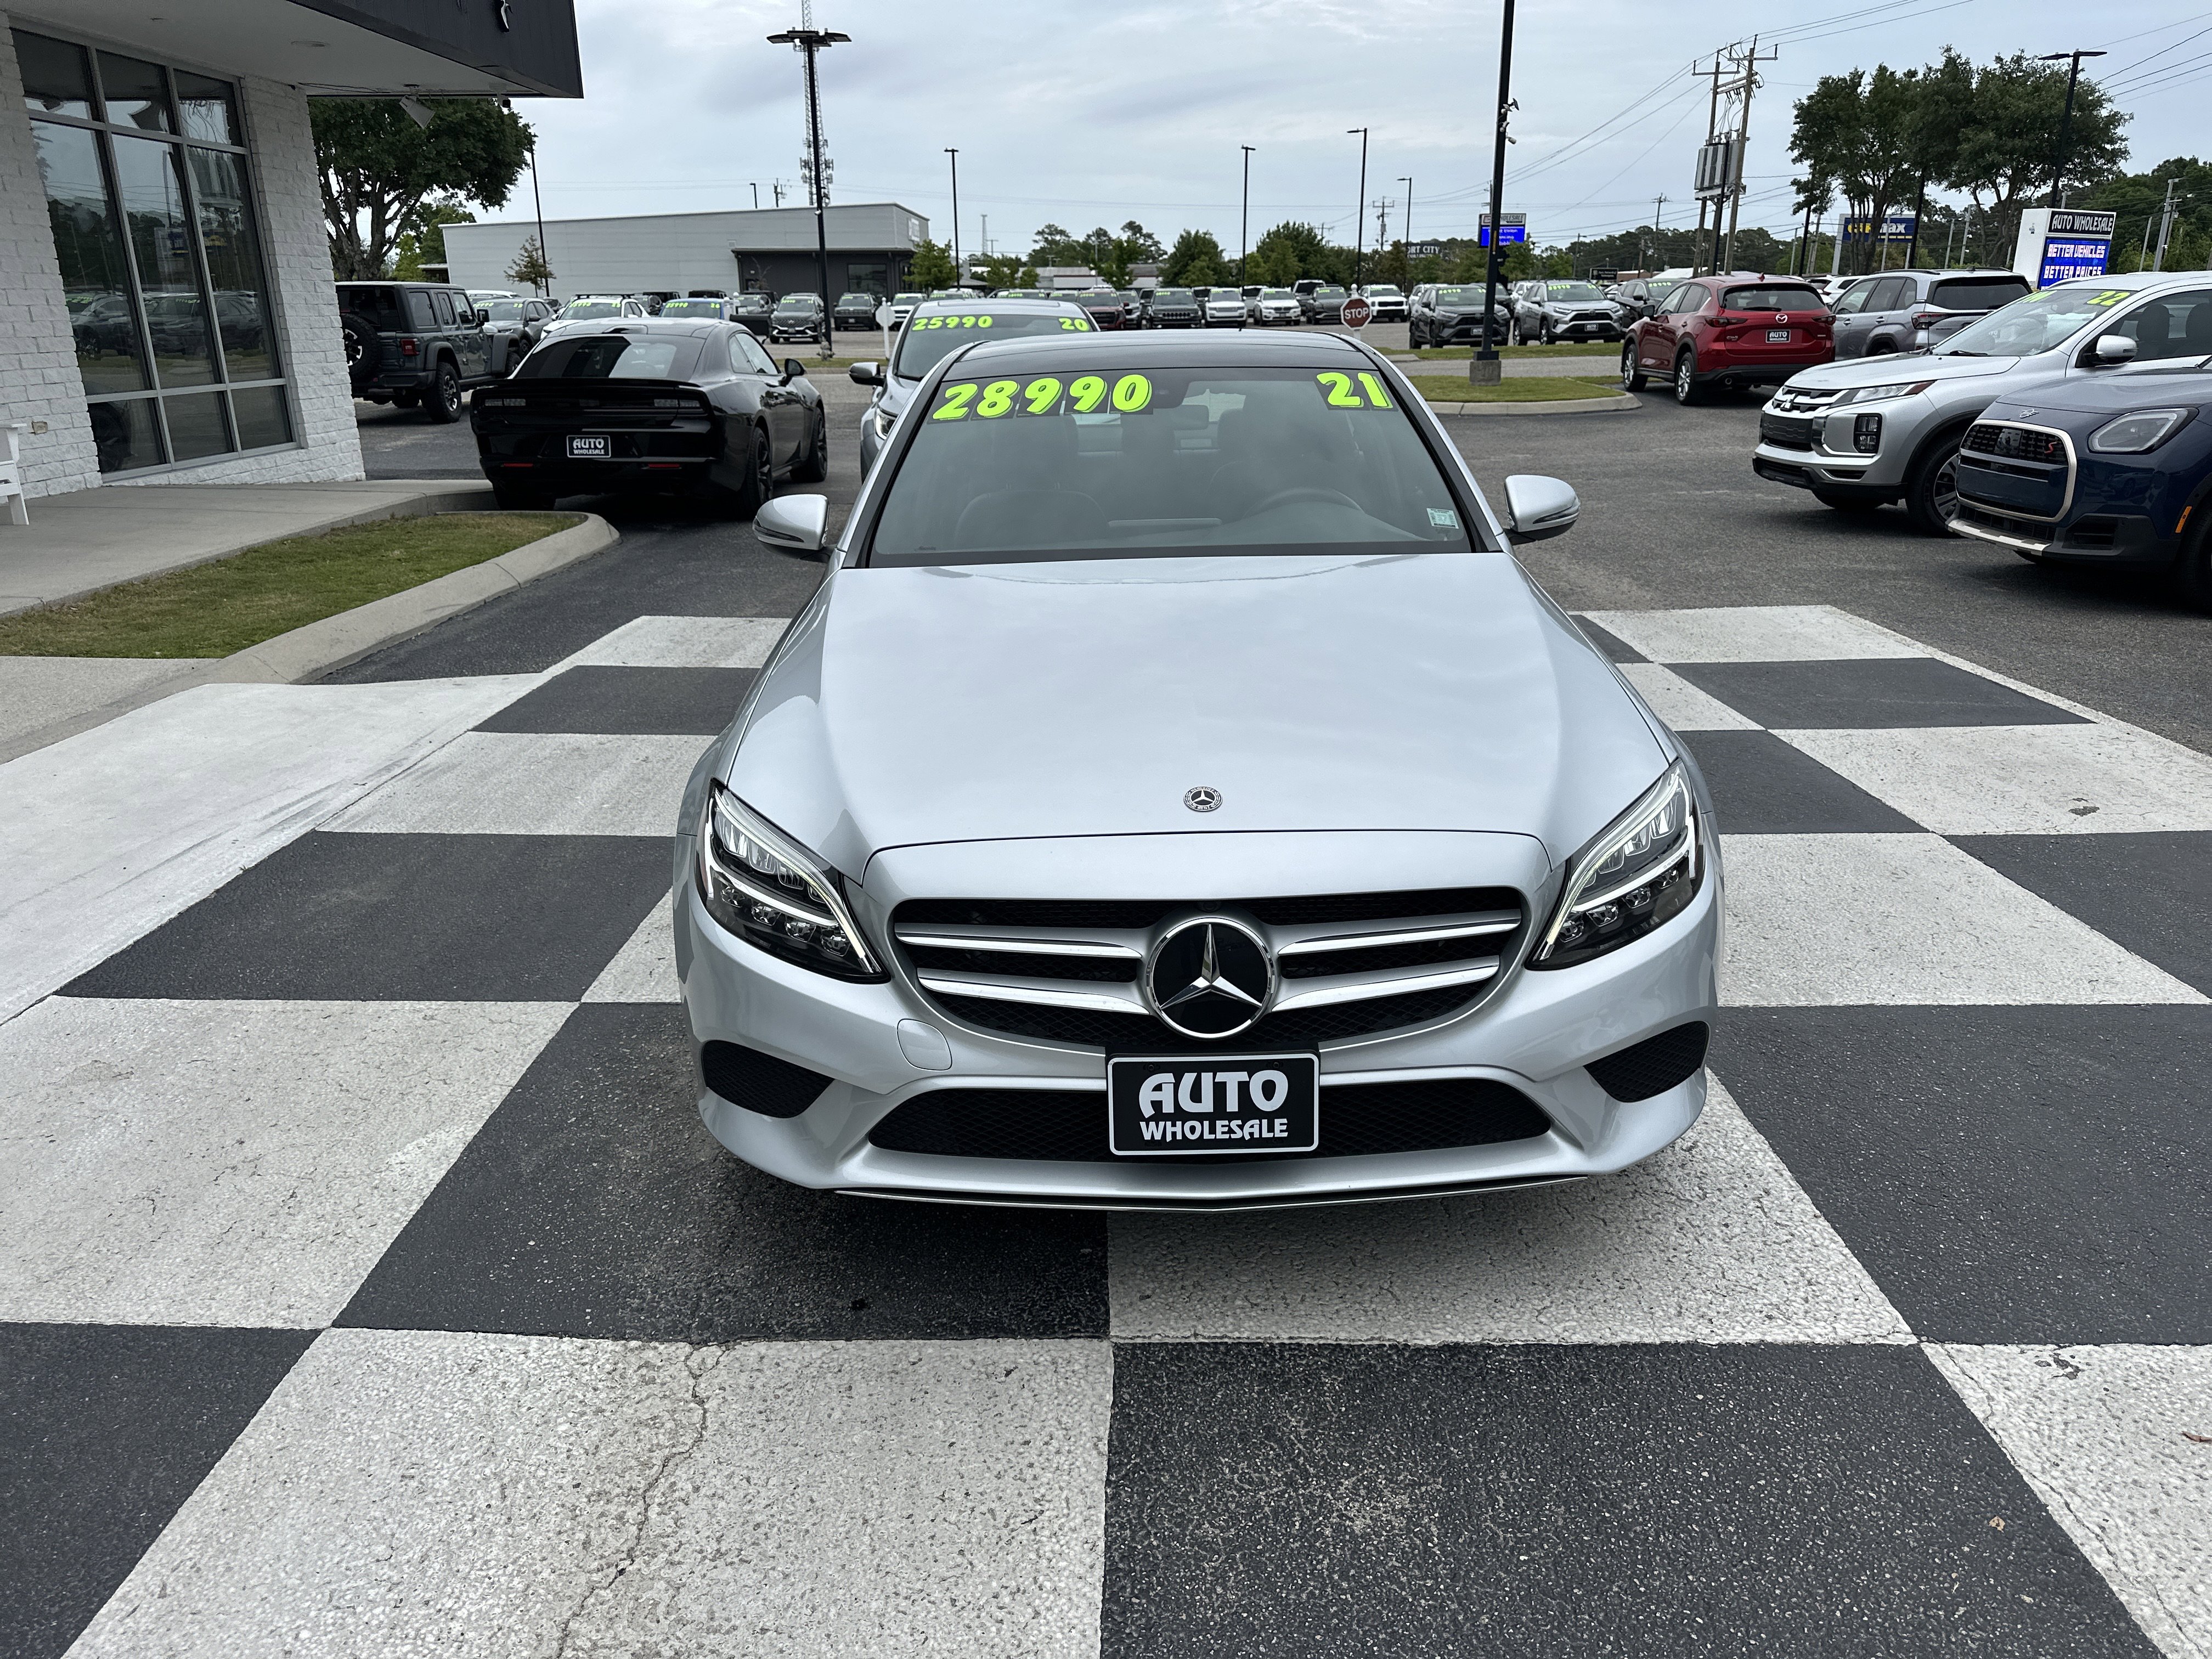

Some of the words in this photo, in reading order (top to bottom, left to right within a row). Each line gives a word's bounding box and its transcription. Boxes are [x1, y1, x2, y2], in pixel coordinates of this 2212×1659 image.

[2052, 215, 2073, 230] AUTO
[2074, 216, 2113, 232] WHOLESALE
[1423, 245, 1440, 254] CITY
[2047, 244, 2074, 257] BETTER
[2044, 266, 2074, 279] BETTER
[2075, 267, 2102, 278] PRICES
[2086, 291, 2130, 307] 22
[1344, 307, 1369, 320] STOP
[912, 315, 993, 331] 25990
[1058, 318, 1089, 331] 20
[932, 374, 1153, 420] 28990
[1316, 372, 1393, 409] 21
[573, 438, 604, 449] AUTO
[1139, 1070, 1288, 1118] AUTO
[1139, 1118, 1288, 1142] WHOLESALE
